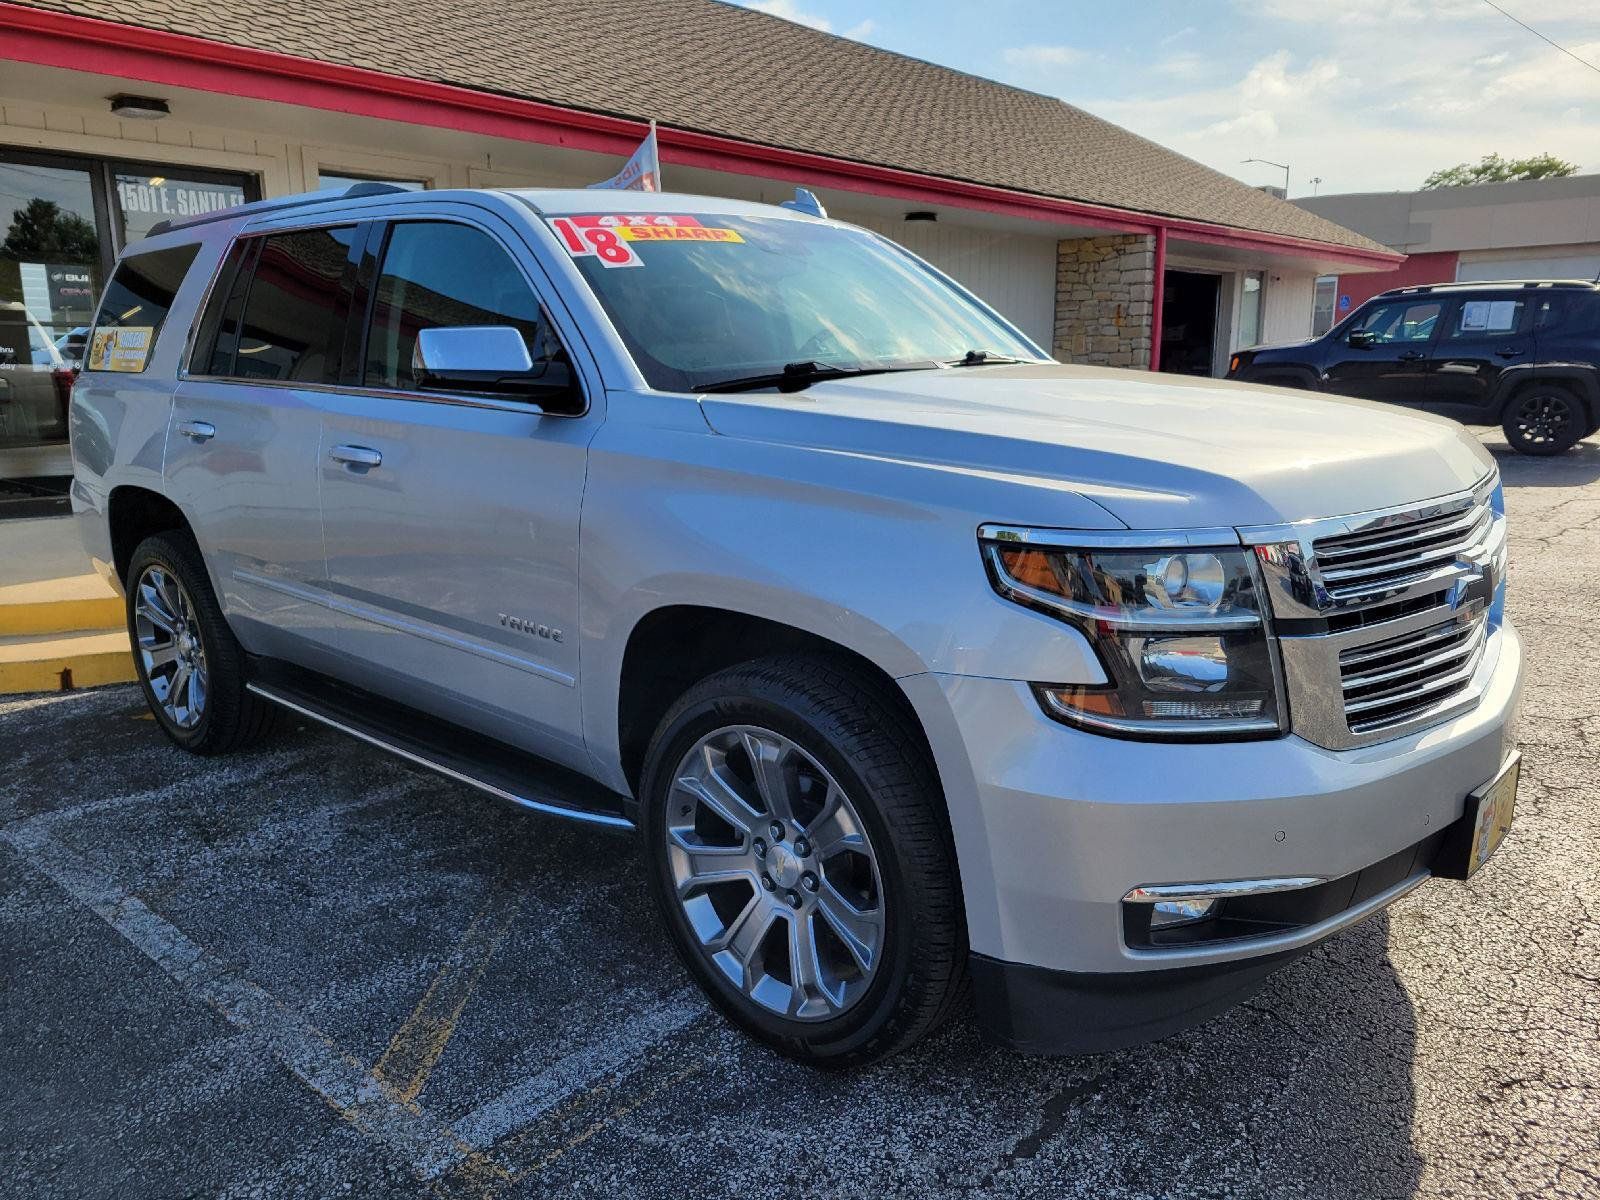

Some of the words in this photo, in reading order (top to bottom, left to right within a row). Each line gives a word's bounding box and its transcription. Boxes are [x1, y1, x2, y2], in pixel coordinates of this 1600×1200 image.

[117, 182, 159, 212] 1501
[176, 189, 227, 216] SANTA
[629, 226, 729, 241] SHARP
[498, 612, 563, 643] TAHOE
